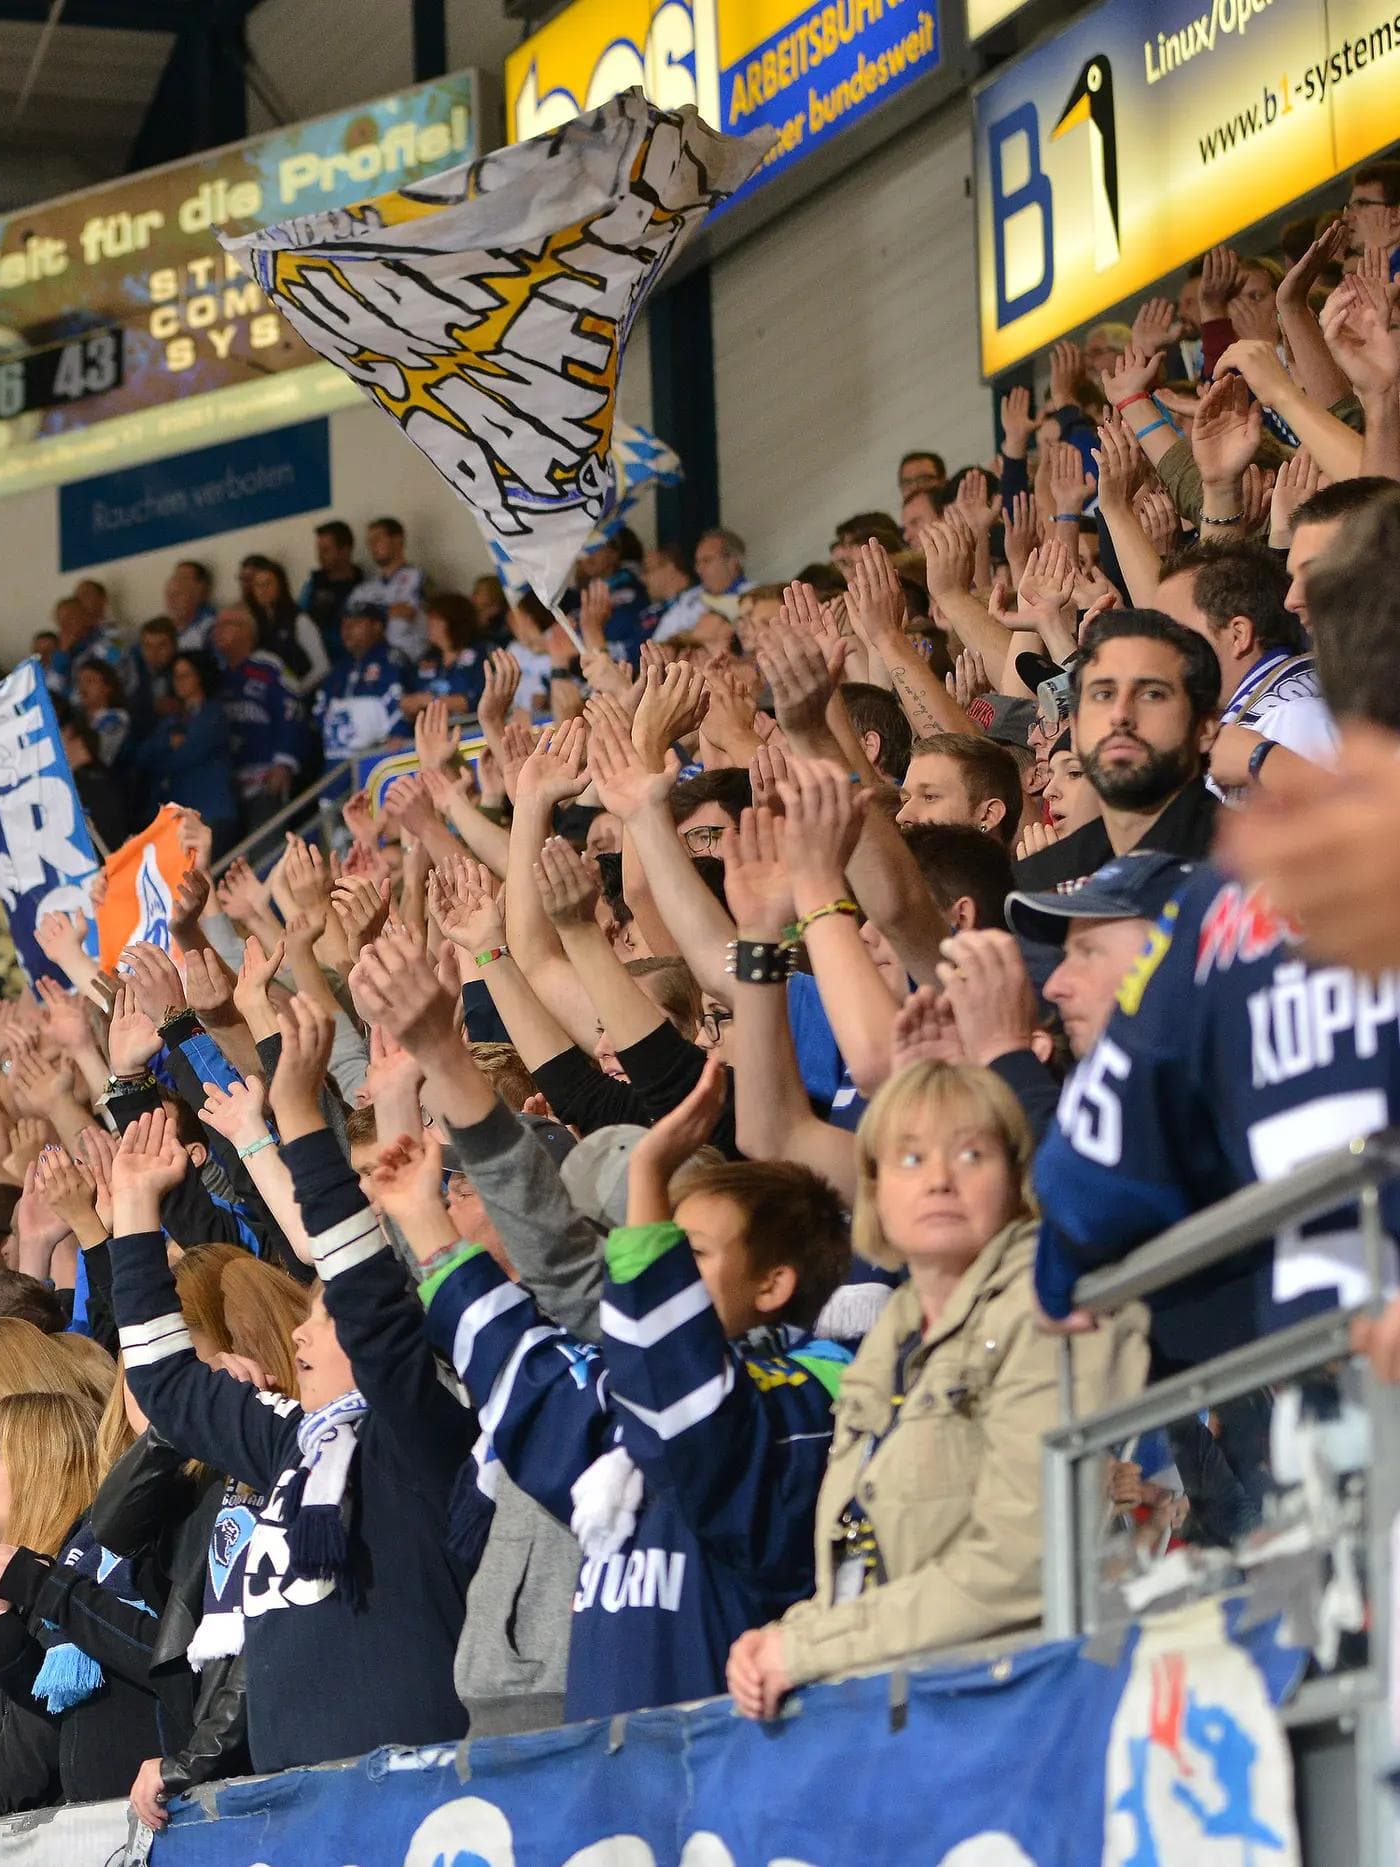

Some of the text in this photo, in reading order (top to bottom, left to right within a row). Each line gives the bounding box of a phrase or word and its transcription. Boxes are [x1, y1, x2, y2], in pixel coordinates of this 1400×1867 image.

[808, 8, 935, 134] bundesweit
[80, 210, 166, 264] für
[178, 177, 261, 235] die
[53, 330, 118, 397] 43
